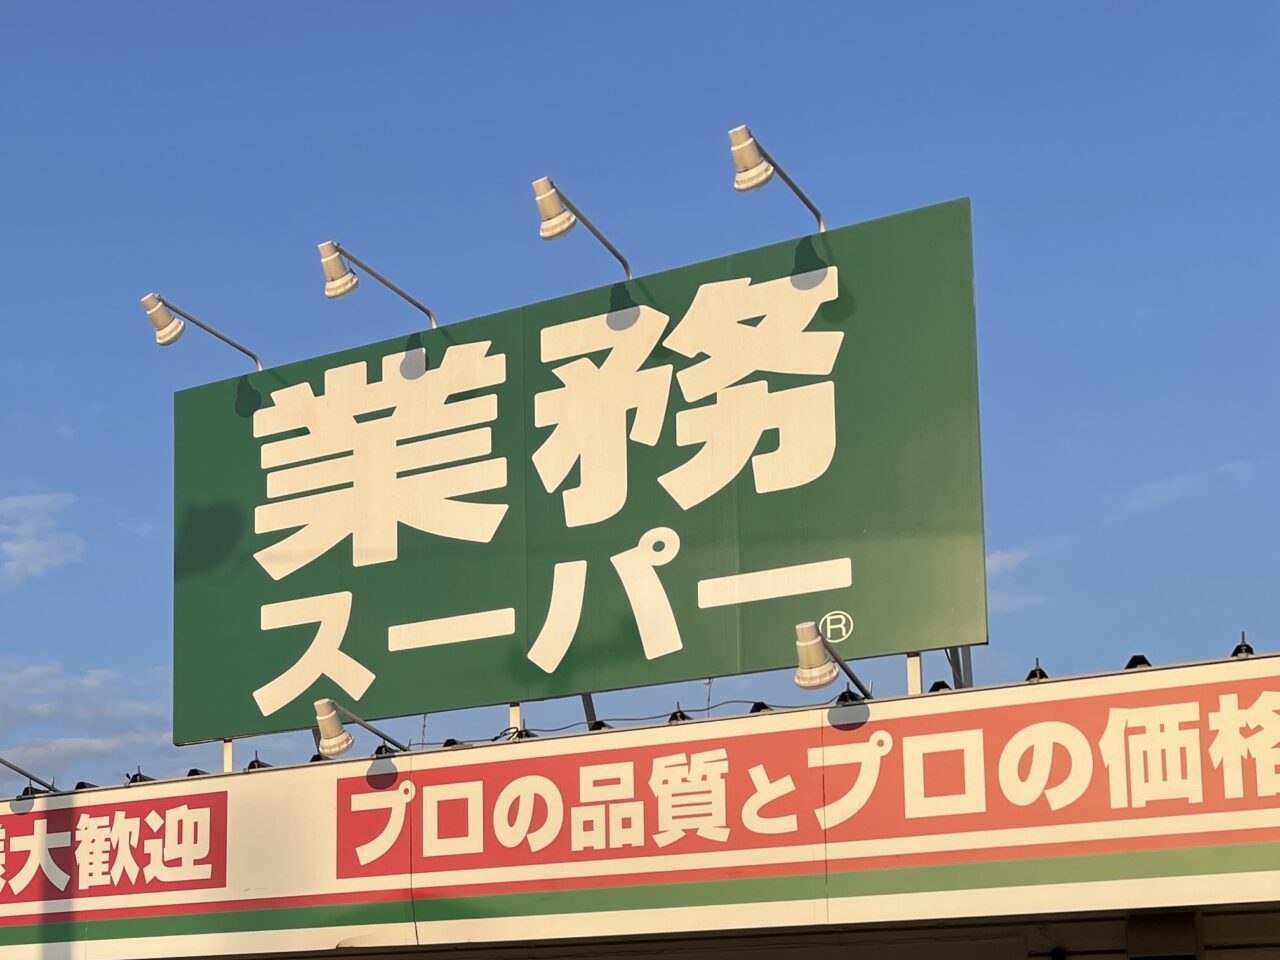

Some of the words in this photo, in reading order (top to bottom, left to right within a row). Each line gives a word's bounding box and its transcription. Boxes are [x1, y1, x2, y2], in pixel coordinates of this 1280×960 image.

[253, 266, 845, 581] 業務
[253, 526, 853, 717] スーパー
[349, 690, 1280, 867] プロの品質とプロの価格
